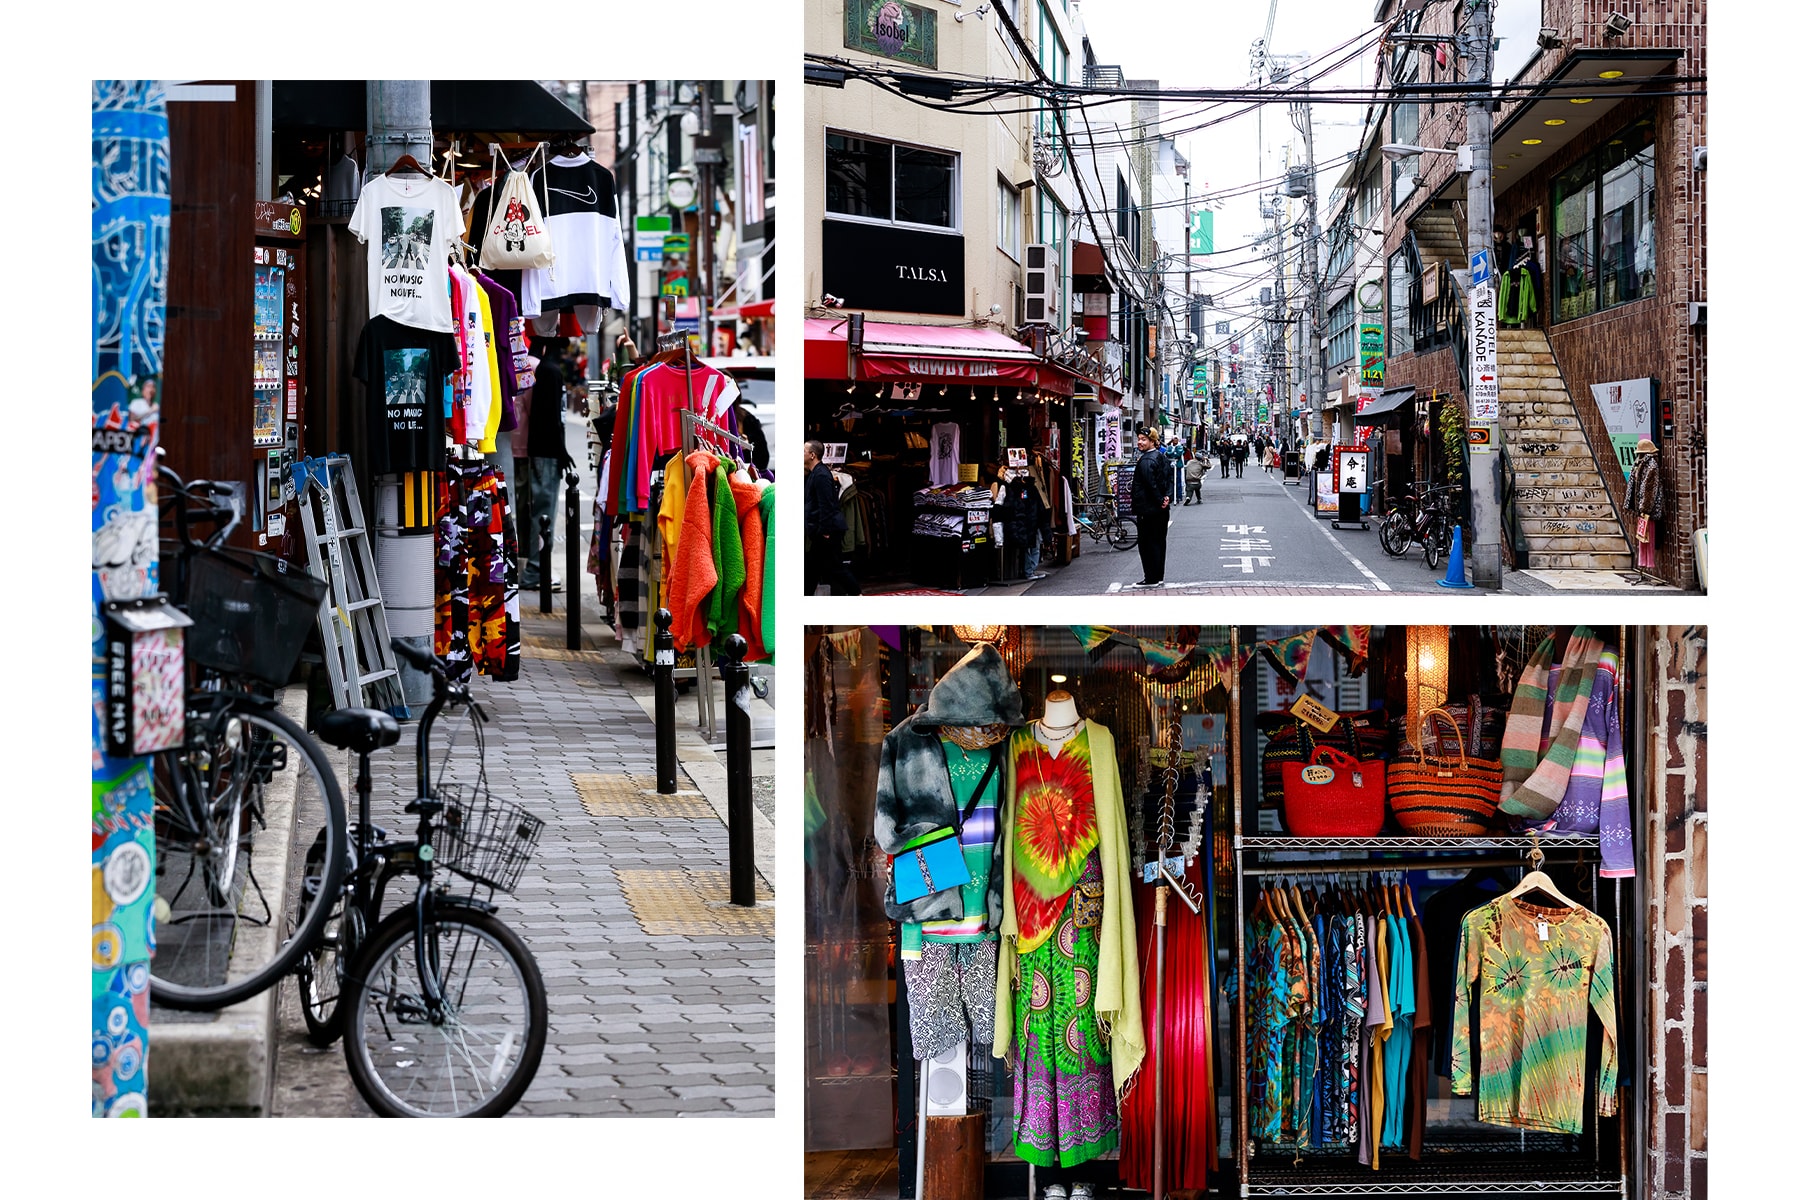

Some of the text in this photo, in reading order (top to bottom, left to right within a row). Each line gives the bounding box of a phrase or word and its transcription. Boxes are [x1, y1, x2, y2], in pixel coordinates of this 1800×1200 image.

[876, 16, 909, 42] Isobel
[384, 274, 424, 285] NO MUSIC
[895, 265, 948, 282] TALSA
[1474, 311, 1487, 362] KANADE
[1487, 318, 1496, 356] HOTEL
[908, 360, 999, 377] ROWDY DOG
[1363, 370, 1383, 380] 11.21
[387, 409, 401, 418] NO
[394, 421, 406, 430] NO
[111, 641, 126, 744] FREE MAP
